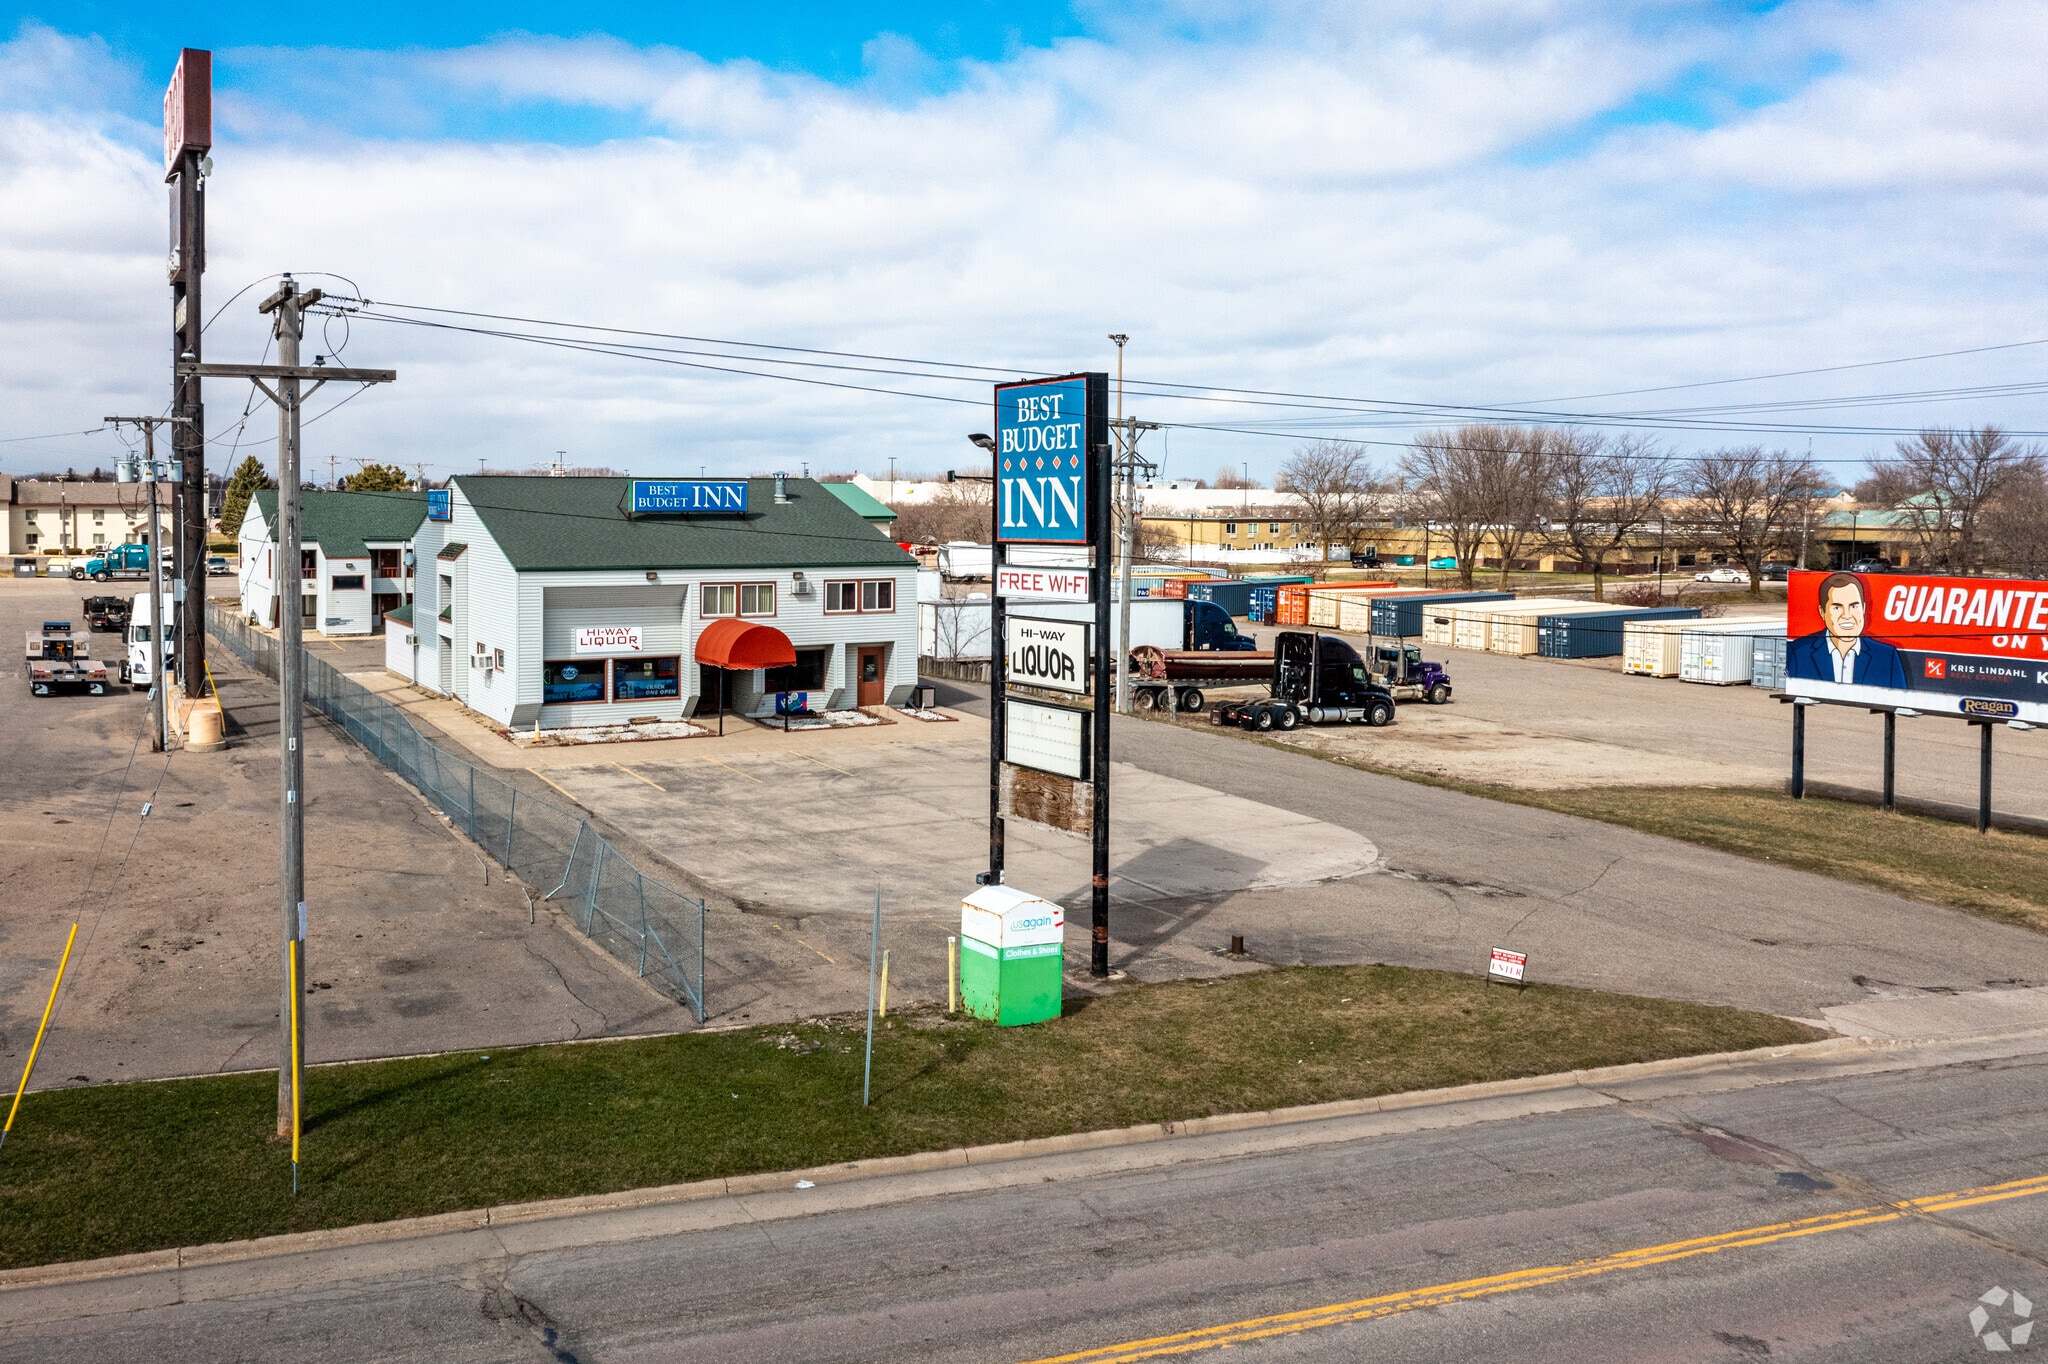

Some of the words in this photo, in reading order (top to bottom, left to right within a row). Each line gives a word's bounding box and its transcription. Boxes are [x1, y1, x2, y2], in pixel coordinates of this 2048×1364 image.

[1017, 394, 1063, 423] BEST
[1002, 423, 1081, 453] BUDGET
[649, 485, 678, 495] BEST
[692, 485, 744, 508] INN
[638, 497, 688, 508] BUDGET
[1002, 475, 1081, 528] INN
[1000, 572, 1043, 592] FREE
[1049, 574, 1088, 595] WI-FI
[587, 627, 631, 636] HI-WAY
[1021, 628, 1065, 642] HI-WAY
[580, 636, 638, 646] LIQUOR
[1991, 634, 2028, 650] ON
[1012, 645, 1075, 682] LIQUOR
[1950, 664, 1975, 673] KRIS
[1979, 666, 2027, 678] LINDAHL
[1964, 699, 2013, 714] Reagan
[1012, 916, 1052, 930] usagain
[1005, 948, 1031, 958] Clothes
[1038, 946, 1058, 954] Shoes
